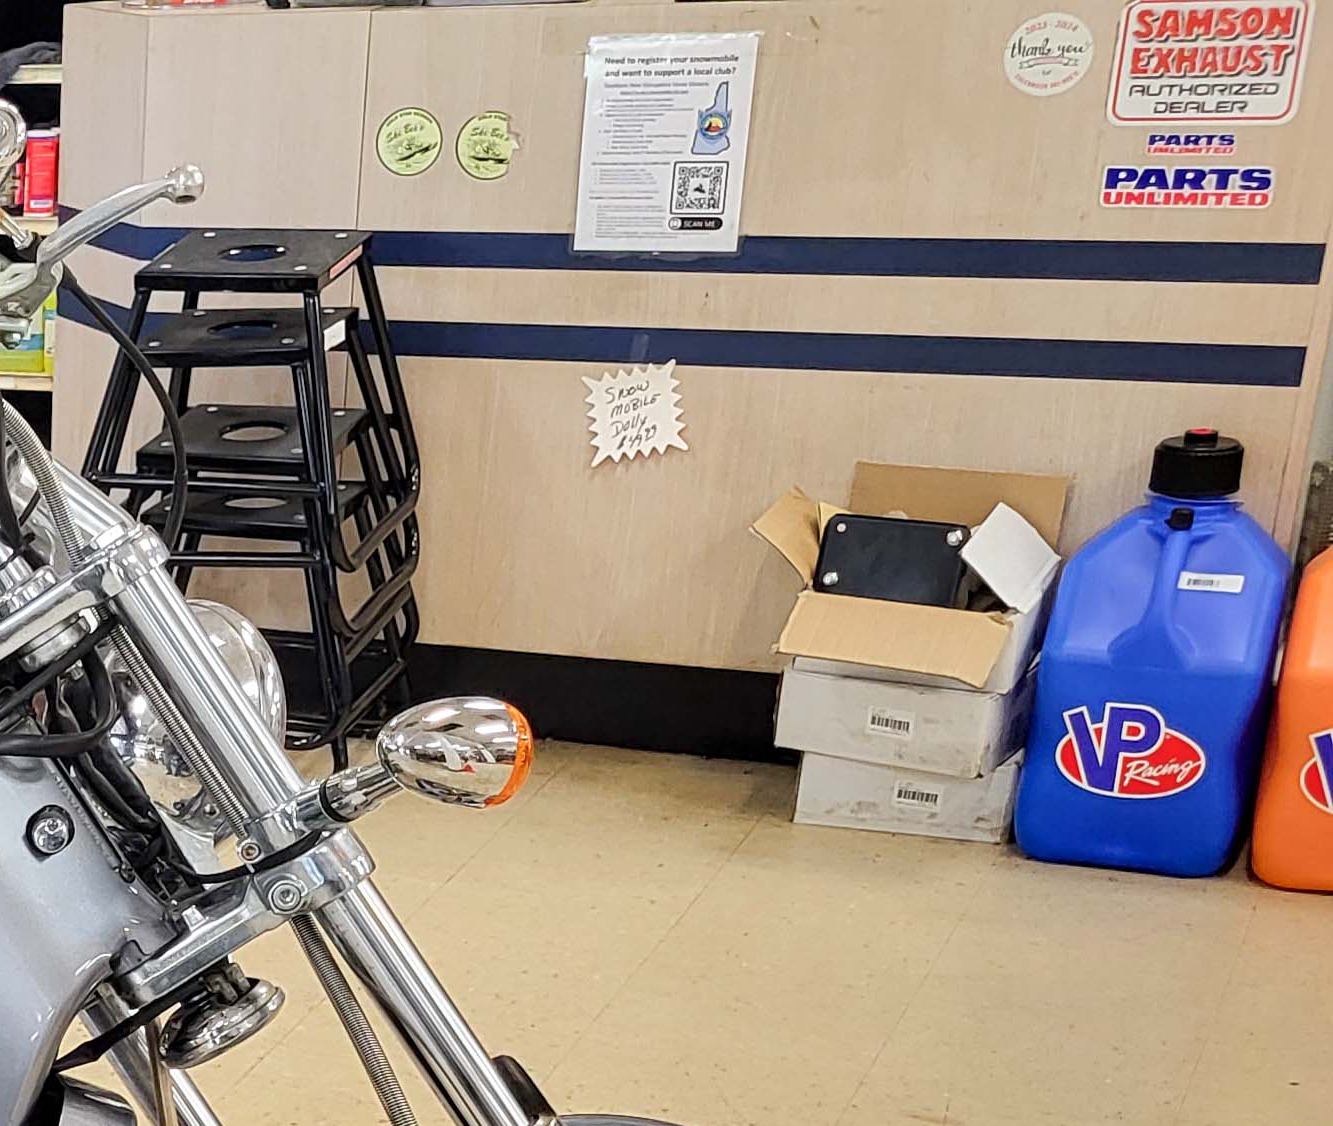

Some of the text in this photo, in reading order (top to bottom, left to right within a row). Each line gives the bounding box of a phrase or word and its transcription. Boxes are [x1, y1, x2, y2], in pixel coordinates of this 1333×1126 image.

[1133, 7, 1297, 41] SAMSON
[1011, 37, 1086, 59] thank you
[604, 57, 626, 65] Need
[637, 57, 668, 66] register
[670, 57, 688, 66] your
[689, 54, 739, 63] snowmobile
[1129, 45, 1294, 78] EXHAUST
[654, 69, 685, 79] support
[694, 68, 712, 76] local
[714, 67, 736, 76] club?
[1129, 83, 1279, 97] AUTHORIZED
[1153, 101, 1248, 114] DEALER
[1148, 135, 1235, 146] PARTS
[1104, 168, 1272, 190] PARTS
[1102, 192, 1269, 206] UNLIMITED
[683, 220, 716, 229] SCAN ME
[1064, 702, 1165, 793] VP
[1122, 758, 1203, 786] Racing
